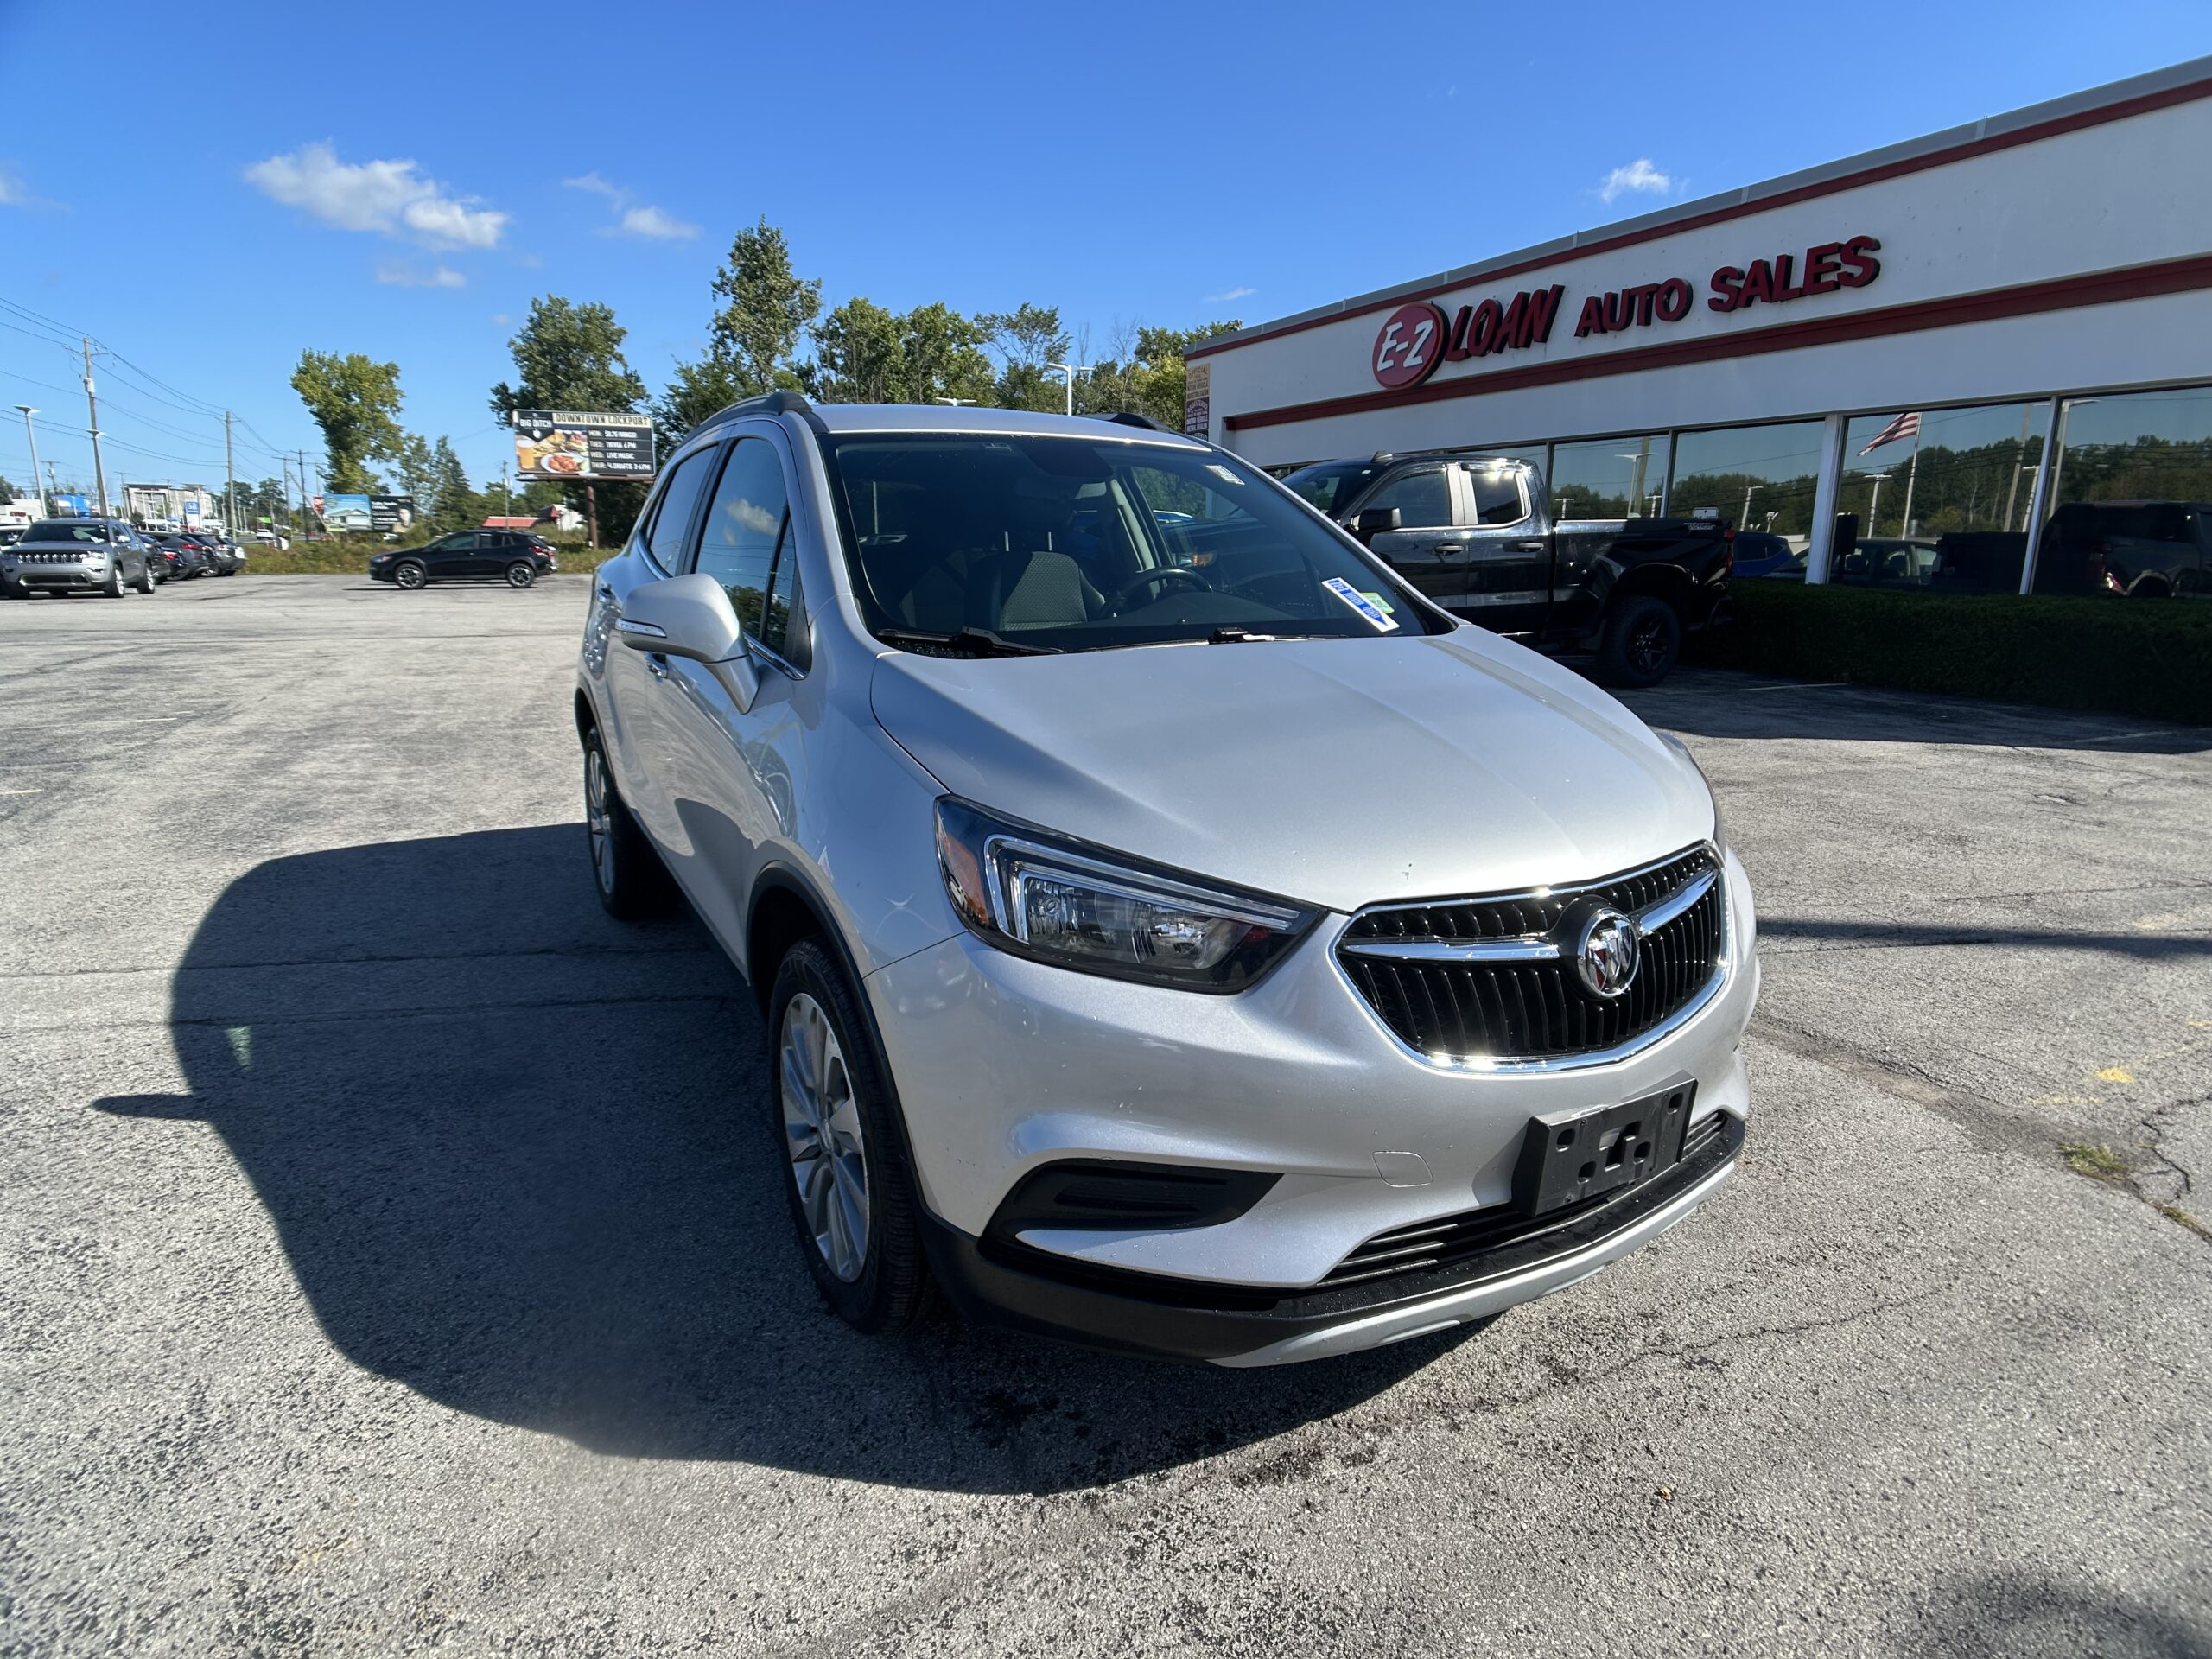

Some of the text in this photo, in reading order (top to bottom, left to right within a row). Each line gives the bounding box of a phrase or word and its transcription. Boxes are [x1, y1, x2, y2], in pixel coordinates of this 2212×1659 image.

[1377, 235, 1881, 372] E-Z LOAN AUTO SALES
[532, 419, 552, 428] DITCH
[556, 413, 648, 426] DOWNTOWN LOCKPORT
